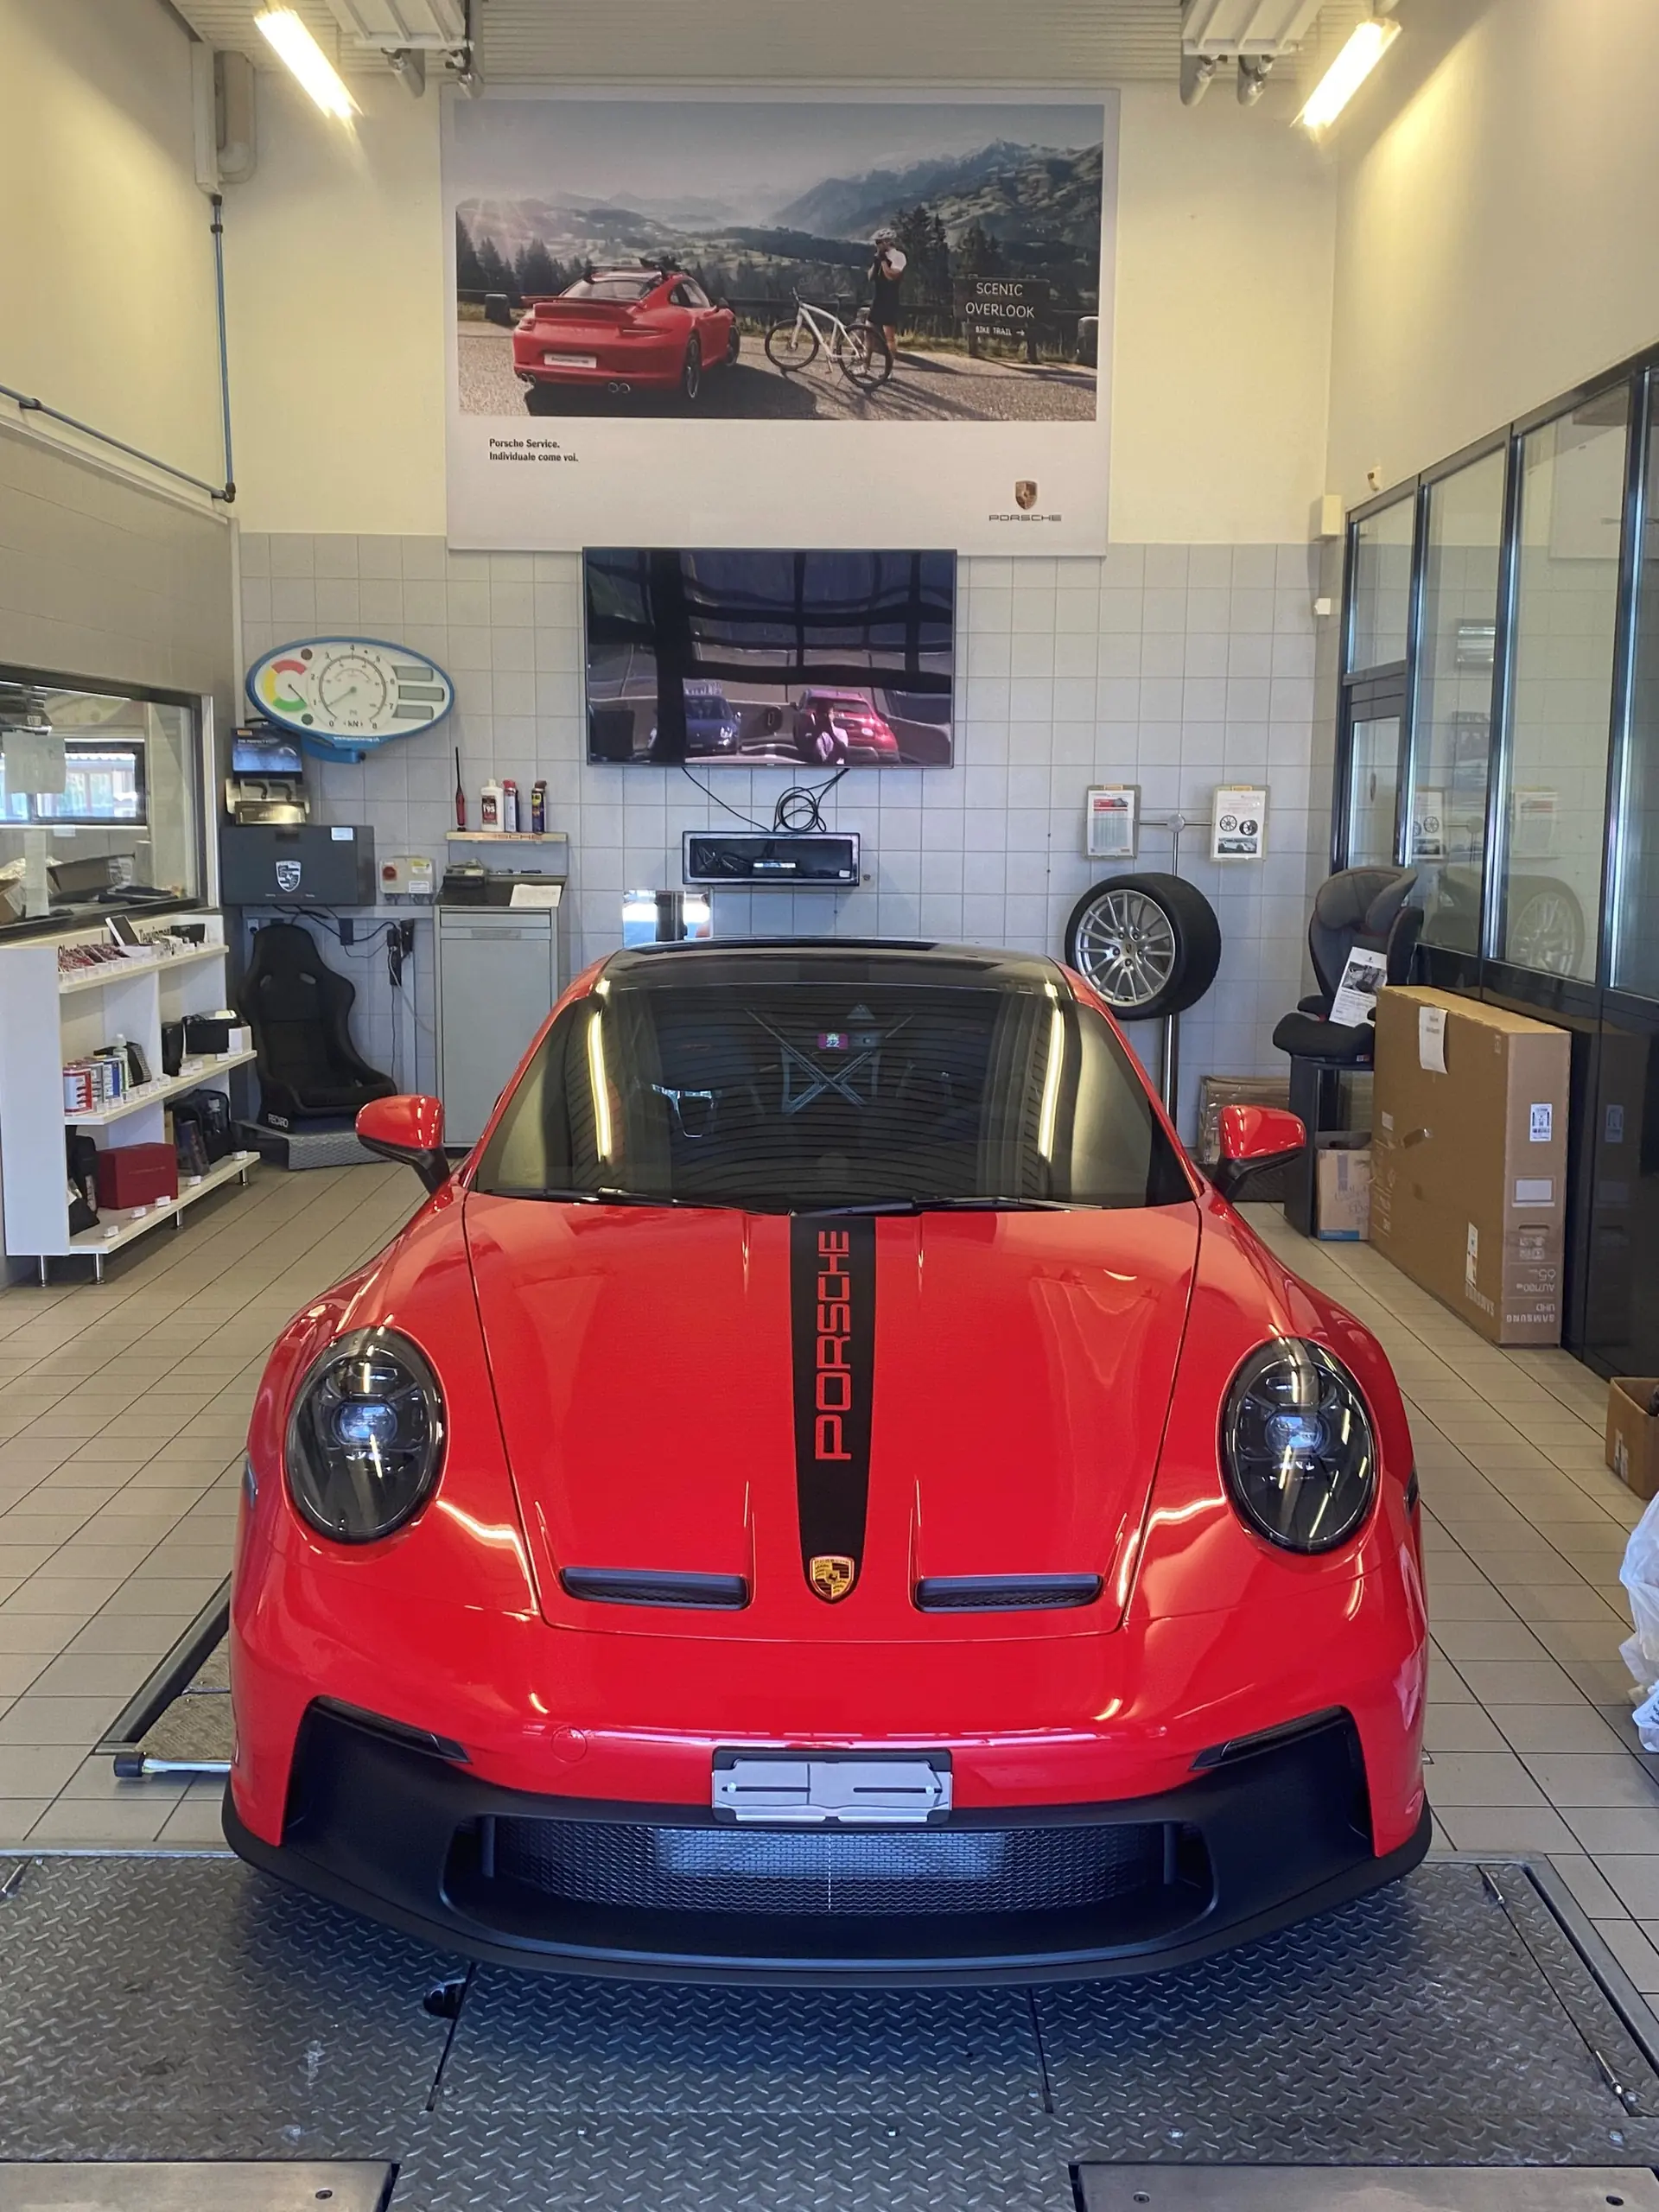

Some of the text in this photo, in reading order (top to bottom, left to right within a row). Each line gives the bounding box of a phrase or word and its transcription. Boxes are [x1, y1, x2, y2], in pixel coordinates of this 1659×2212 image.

[976, 282, 1023, 296] SCENIC
[965, 302, 1035, 319] OVERLOOK
[975, 325, 1012, 336] BIKE TRAIL
[489, 438, 560, 448] Porsche Service.
[489, 451, 536, 461] Individuale
[563, 453, 579, 462] voi.
[1506, 1313, 1555, 1324] SAMSUNG
[815, 1230, 852, 1460] PORSCHE
